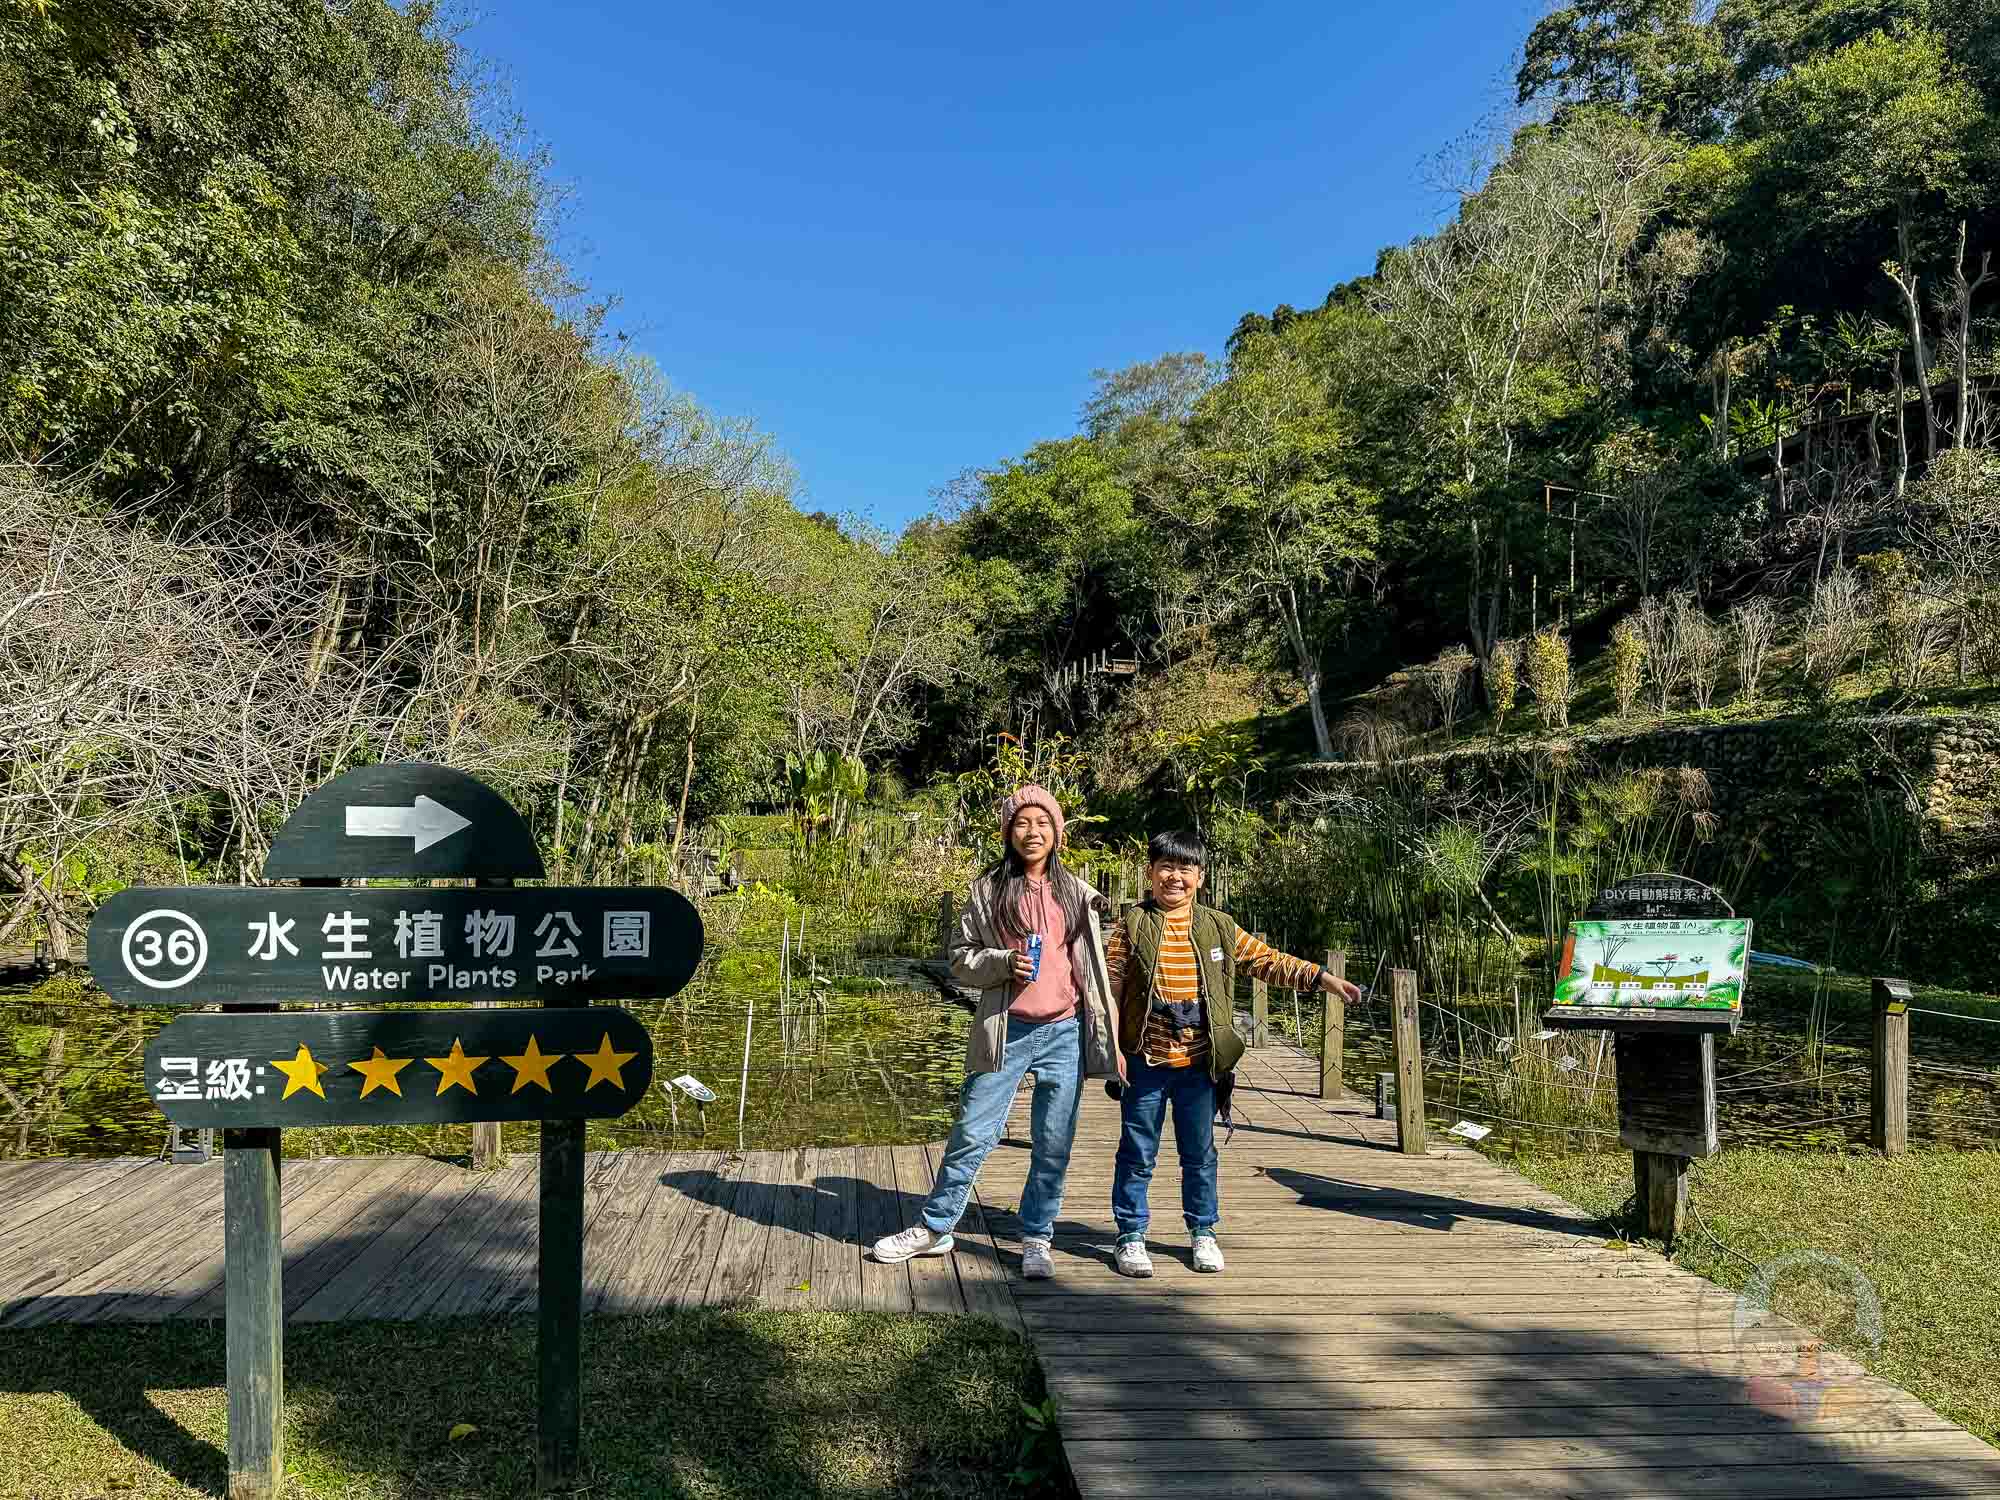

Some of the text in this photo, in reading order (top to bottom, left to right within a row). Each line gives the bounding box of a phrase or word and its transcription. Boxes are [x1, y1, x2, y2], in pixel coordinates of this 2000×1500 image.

[134, 929, 196, 961] 36
[247, 910, 651, 960] 水生植物公園
[322, 964, 597, 991] Water Plants Park
